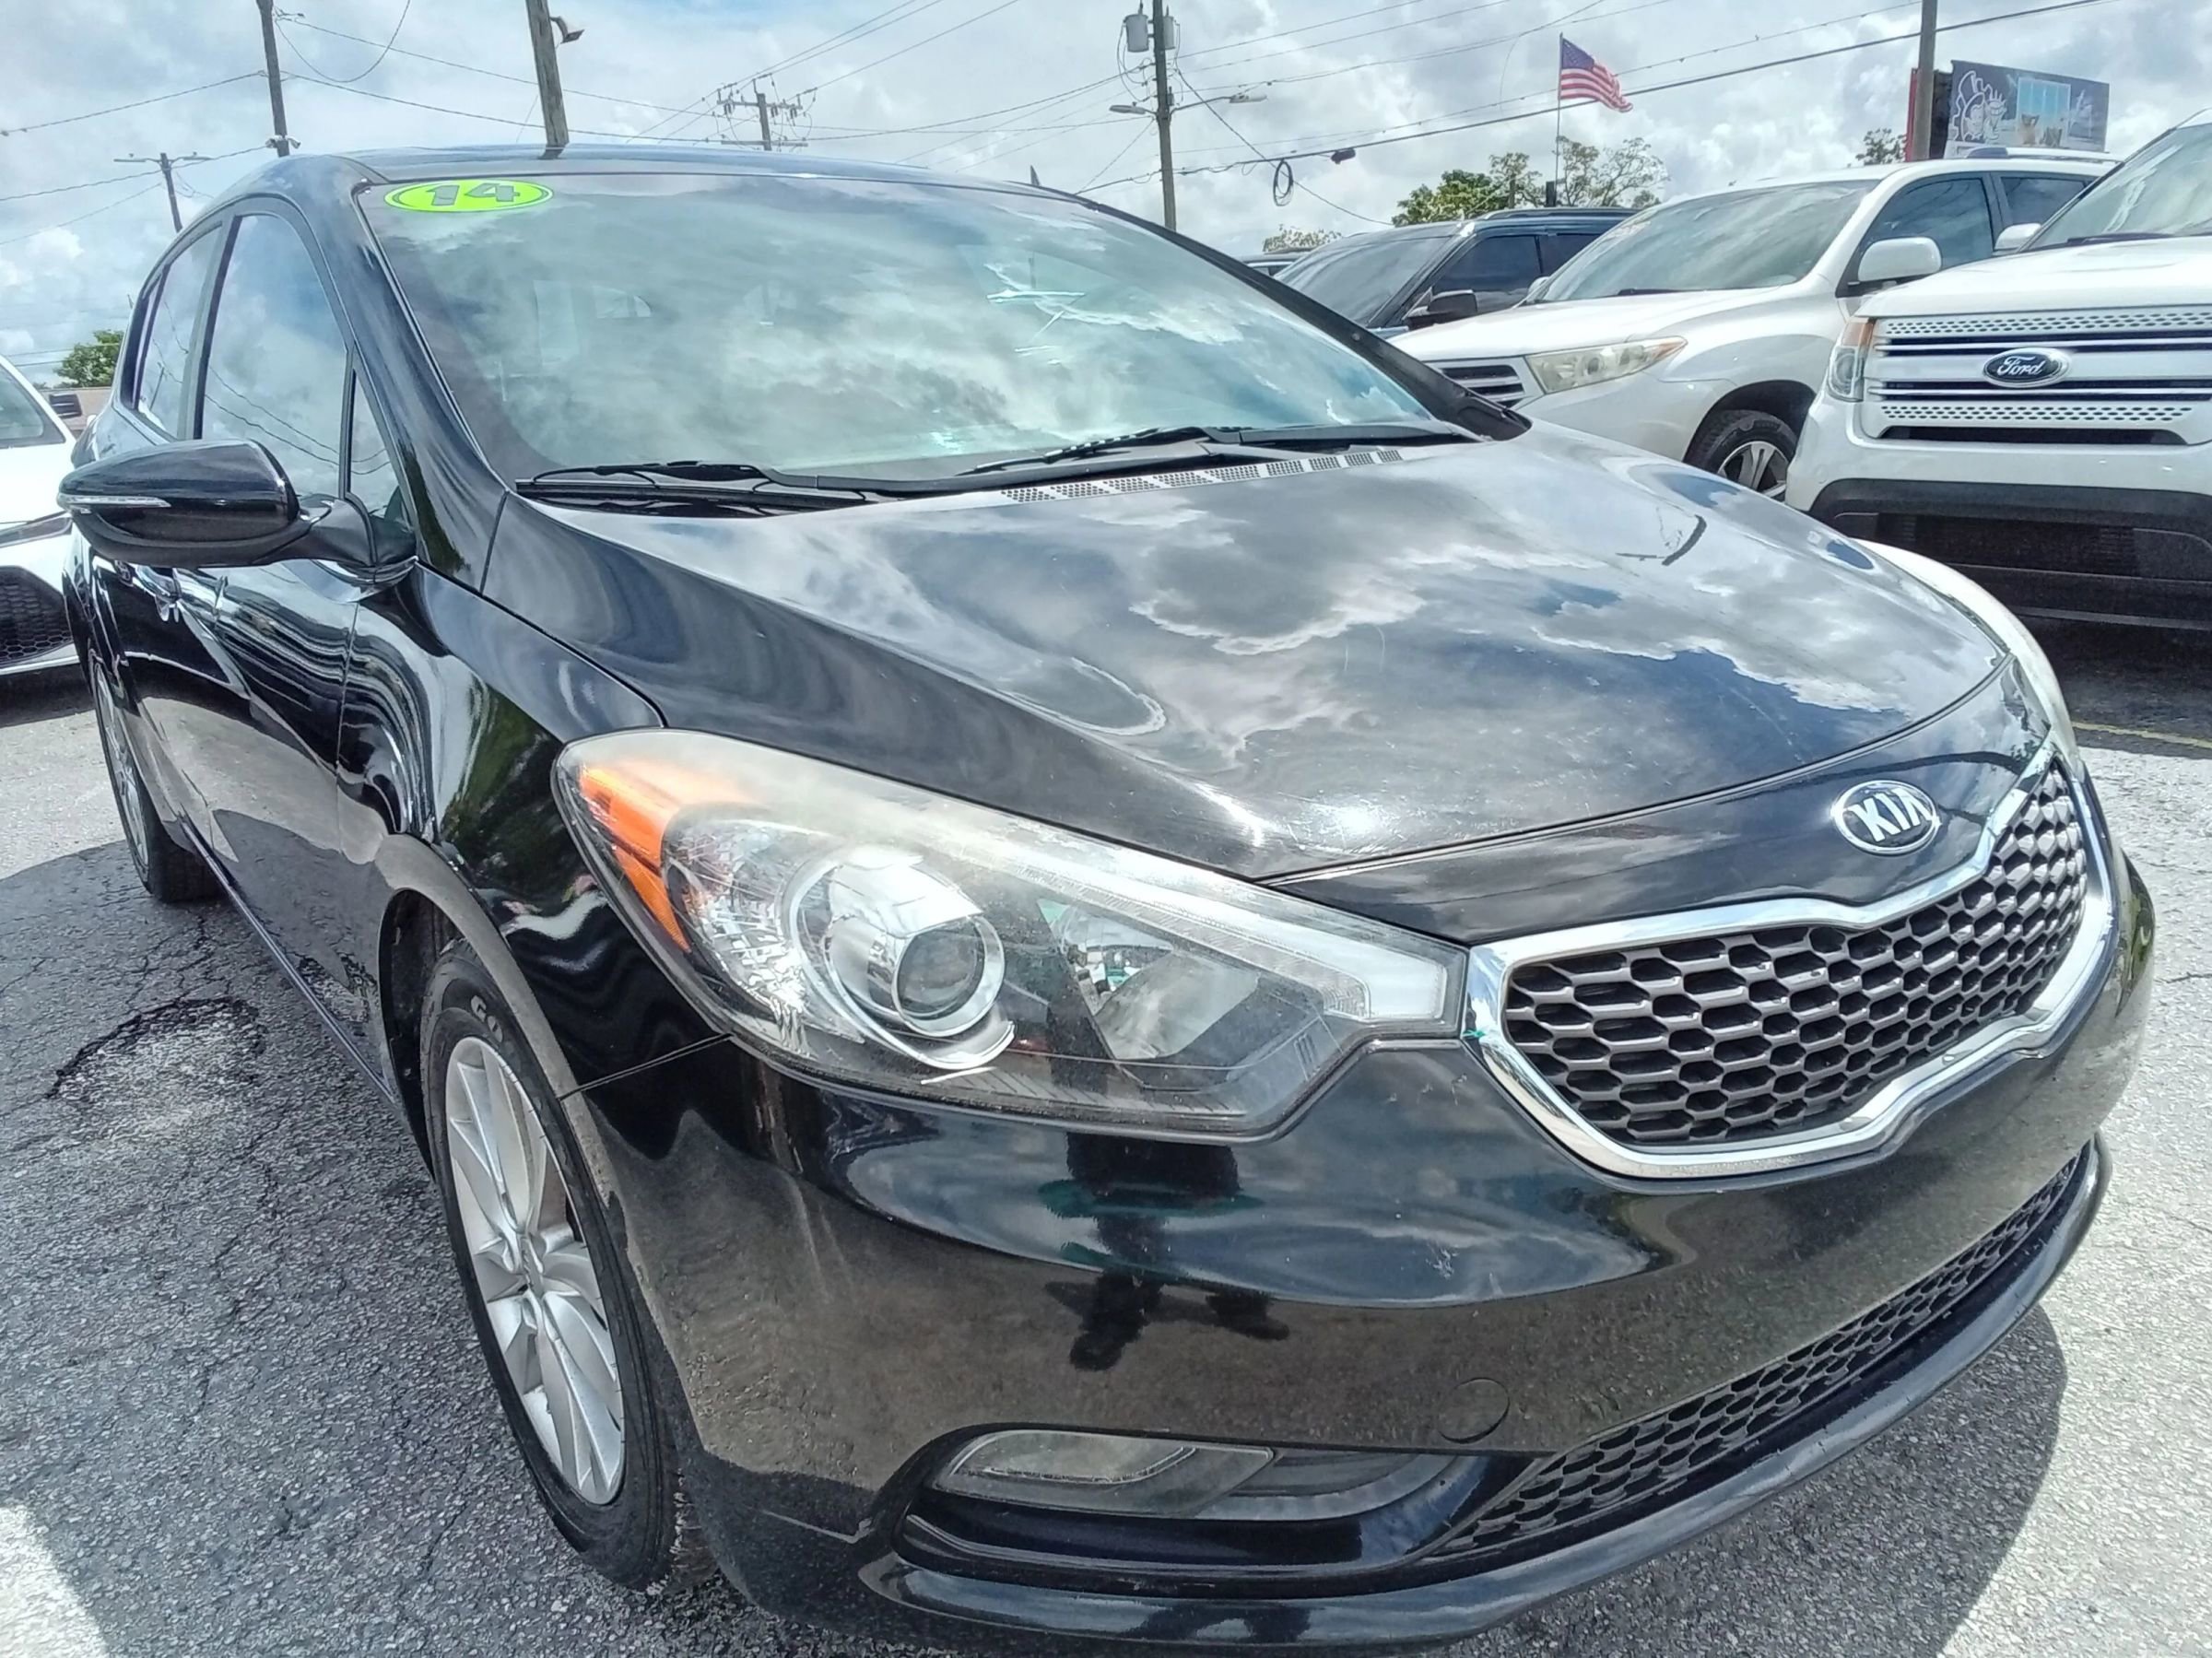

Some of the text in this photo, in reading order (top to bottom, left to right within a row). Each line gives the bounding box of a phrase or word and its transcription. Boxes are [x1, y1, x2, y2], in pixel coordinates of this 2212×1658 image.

[425, 183, 521, 206] 14
[1996, 355, 2046, 376] Ford
[1846, 787, 1933, 842] KIA
